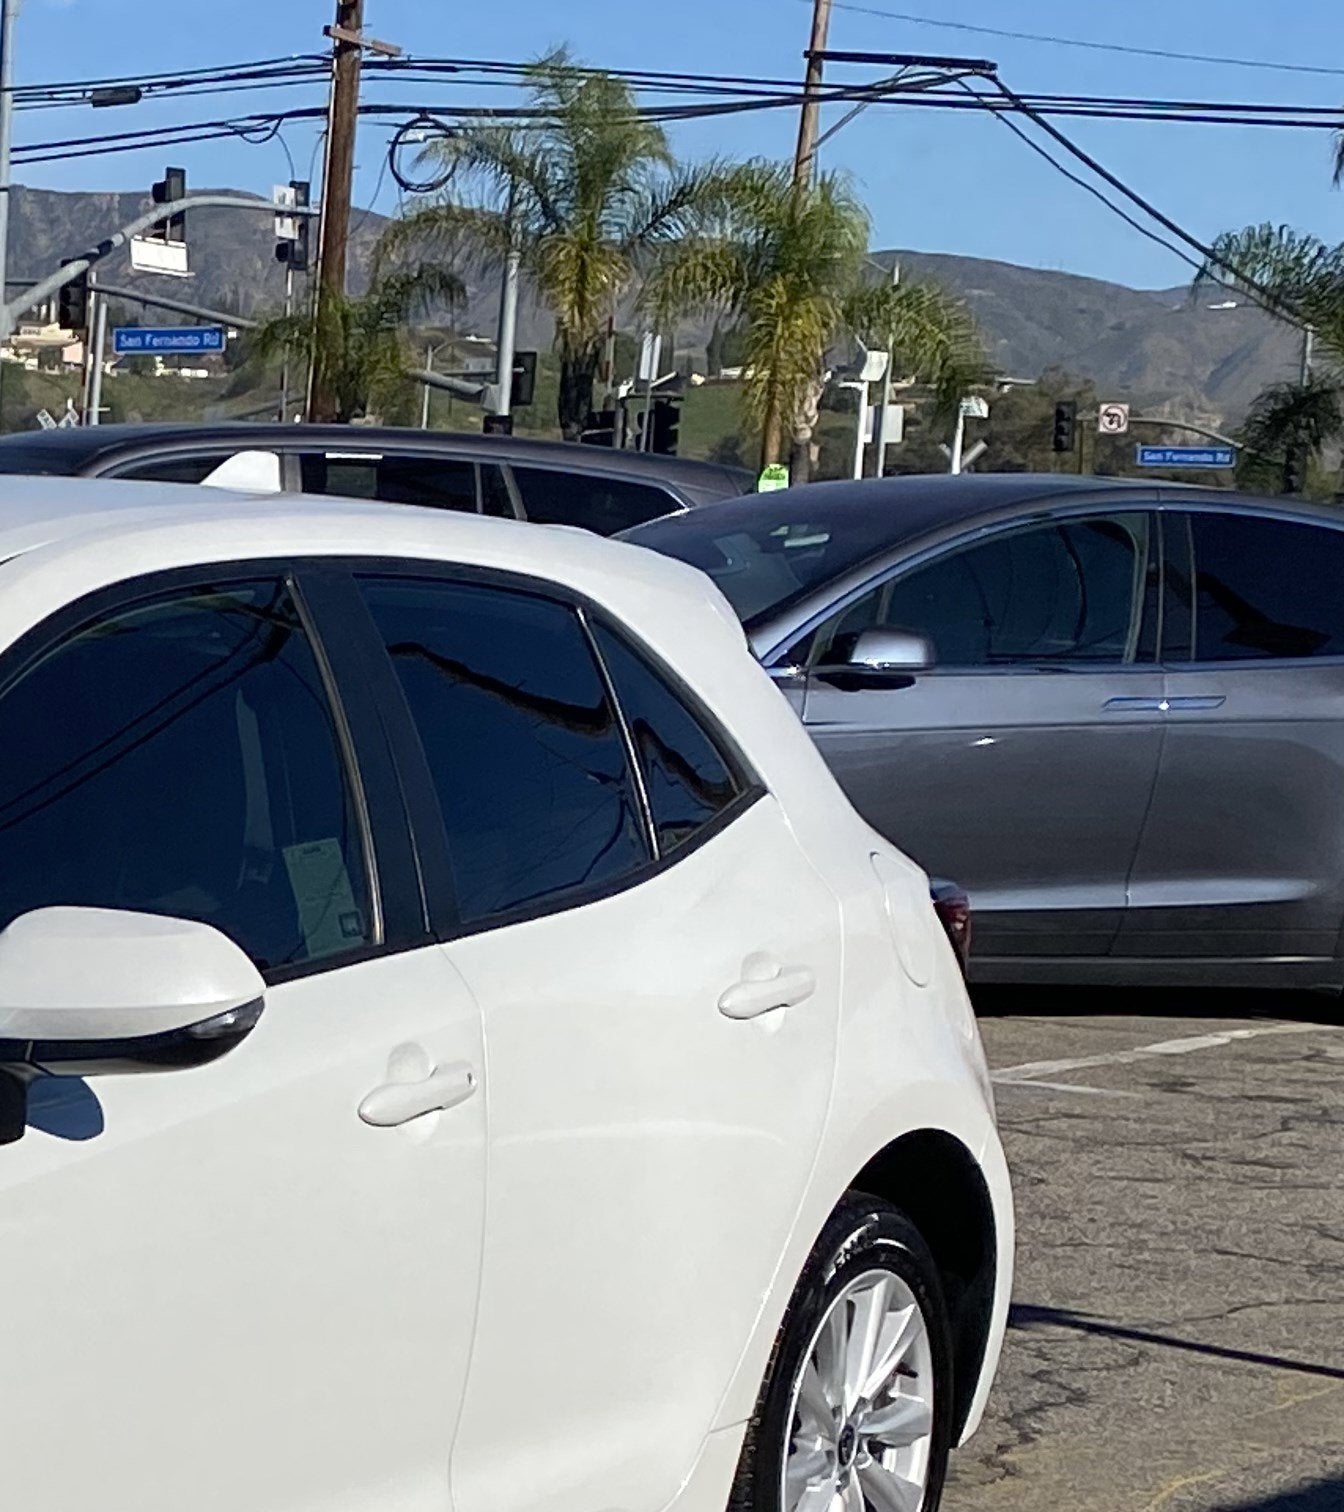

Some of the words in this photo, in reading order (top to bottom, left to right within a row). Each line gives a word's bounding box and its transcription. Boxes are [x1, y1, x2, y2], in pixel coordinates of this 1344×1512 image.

[120, 333, 142, 347] San
[145, 333, 201, 347] Fernando
[203, 332, 220, 346] Rd
